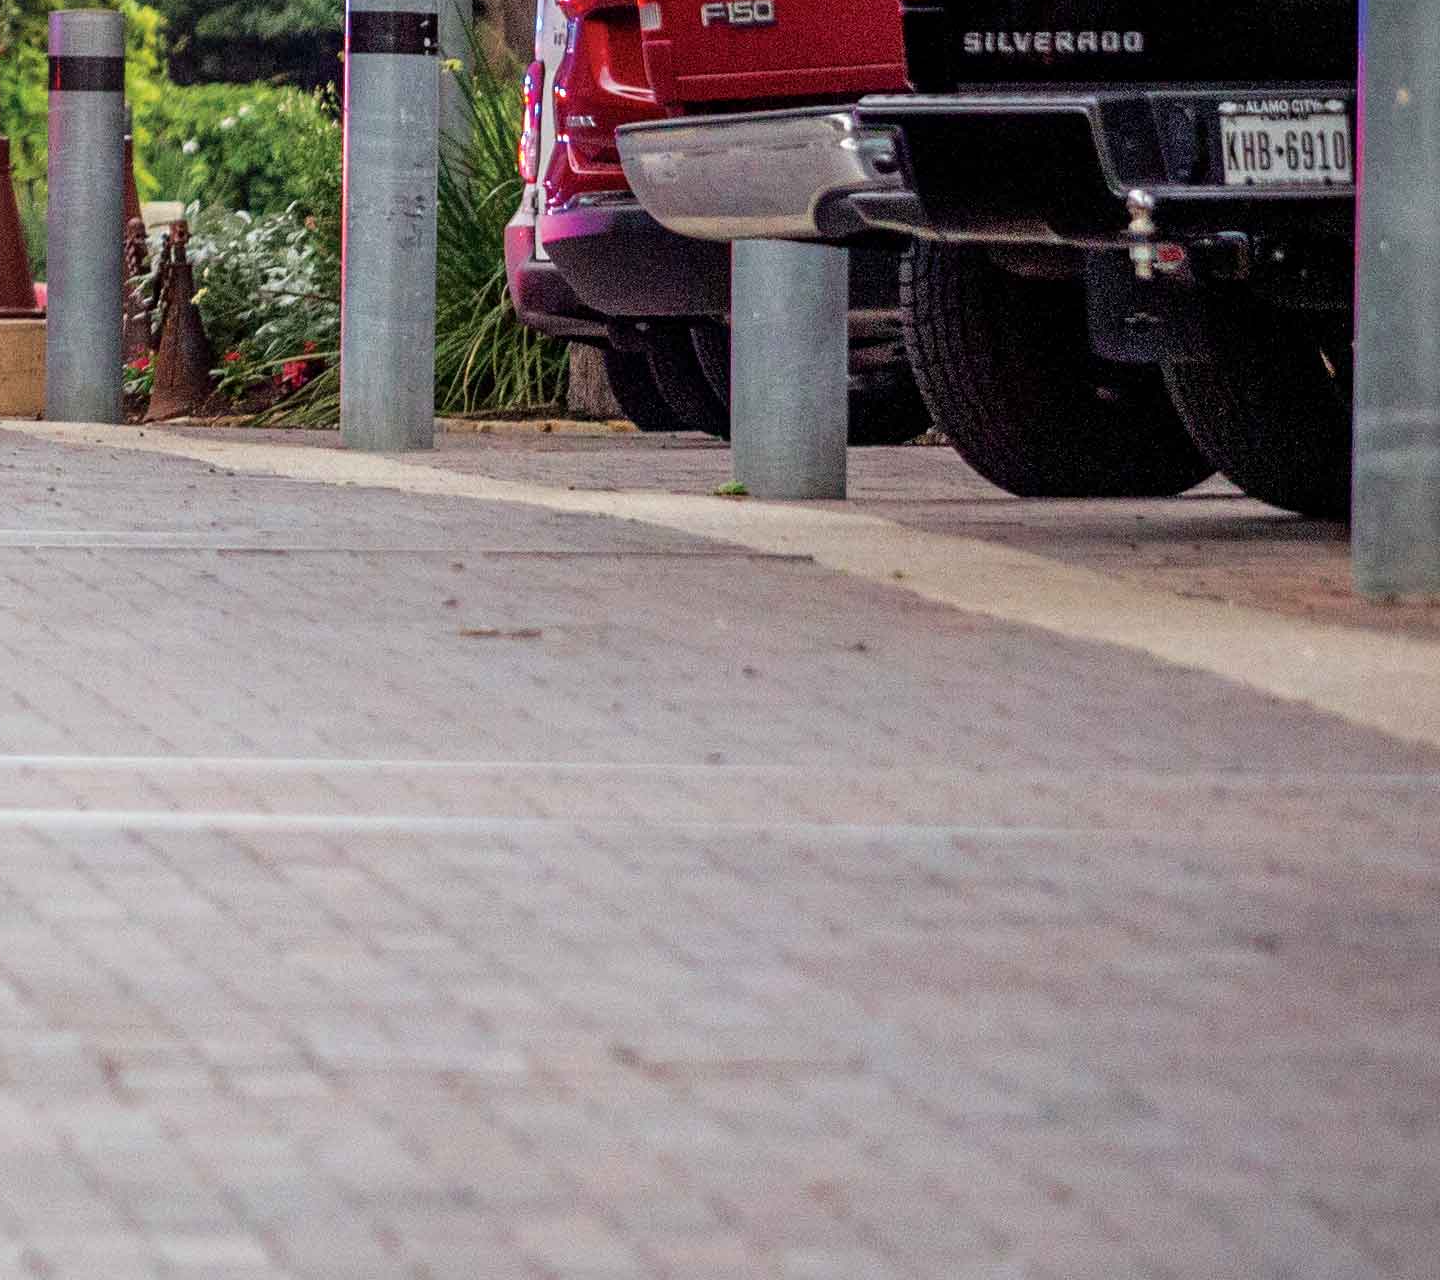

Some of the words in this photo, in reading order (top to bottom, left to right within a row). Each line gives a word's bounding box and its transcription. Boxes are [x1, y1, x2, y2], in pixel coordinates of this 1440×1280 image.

[963, 31, 1145, 53] SILVERADO
[1246, 100, 1289, 113] ALAMO
[1291, 98, 1319, 113] CITY
